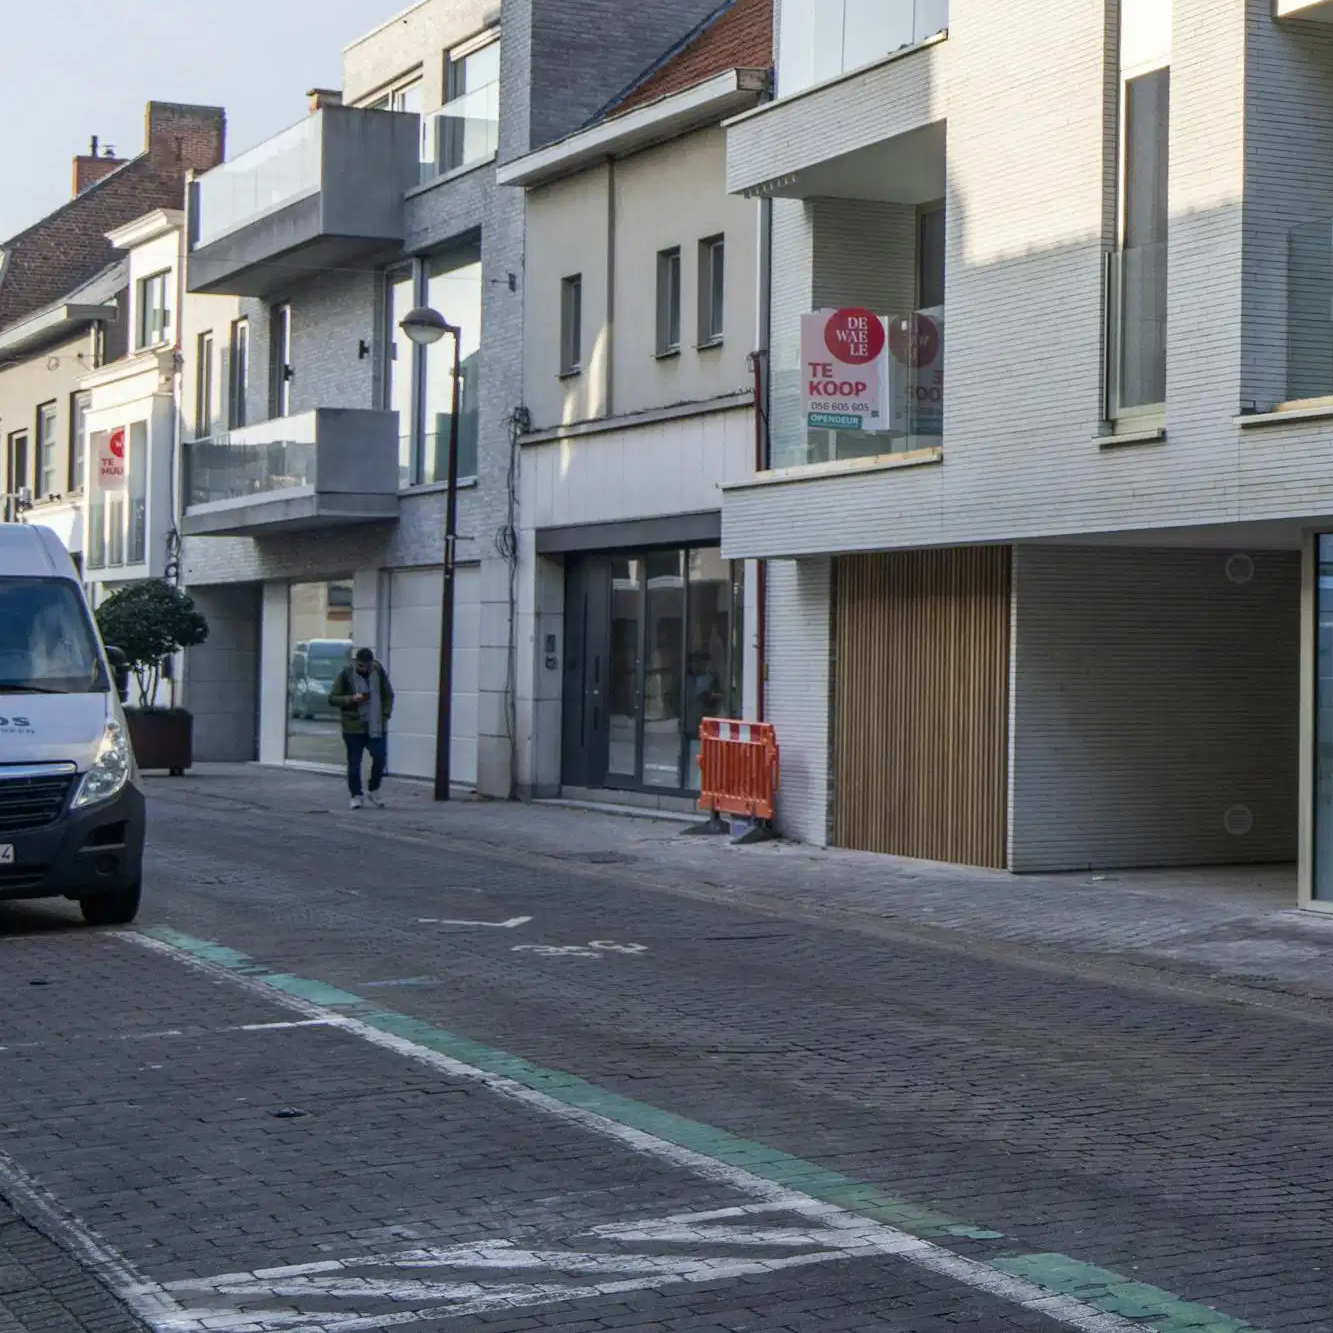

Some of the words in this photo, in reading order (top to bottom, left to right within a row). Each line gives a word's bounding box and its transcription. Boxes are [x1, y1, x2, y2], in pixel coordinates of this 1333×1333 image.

[848, 317, 868, 330] DE
[836, 329, 868, 343] WAE
[850, 344, 868, 356] LE
[808, 362, 832, 378] TE
[809, 380, 867, 397] KOOP
[811, 401, 829, 411] 056
[831, 402, 850, 412] 605
[851, 403, 870, 412] 605
[810, 414, 860, 425] OPENDEUR
